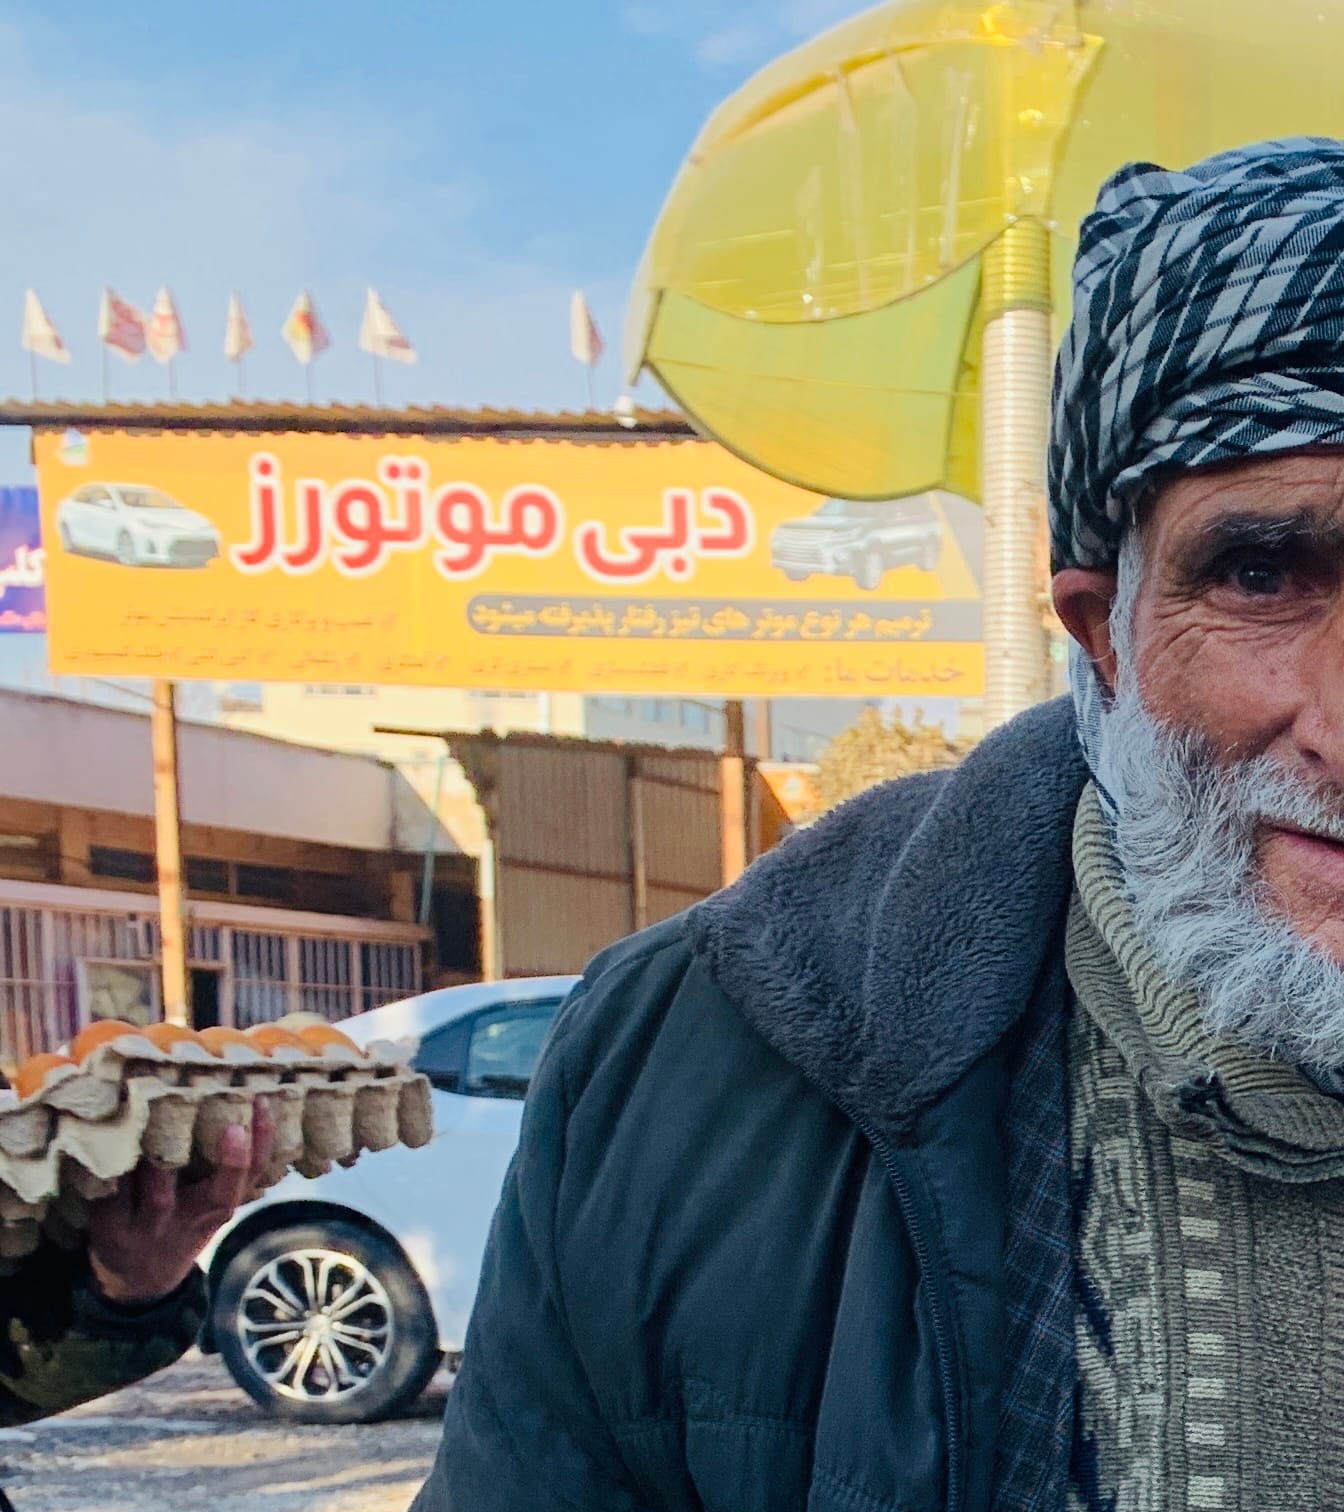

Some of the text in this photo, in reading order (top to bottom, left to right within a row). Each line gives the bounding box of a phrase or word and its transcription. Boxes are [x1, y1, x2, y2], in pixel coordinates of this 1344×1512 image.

[235, 456, 749, 580] دبی موتورز
[752, 606, 798, 639] موتر
[802, 607, 843, 640] نوع
[844, 610, 873, 639] هر
